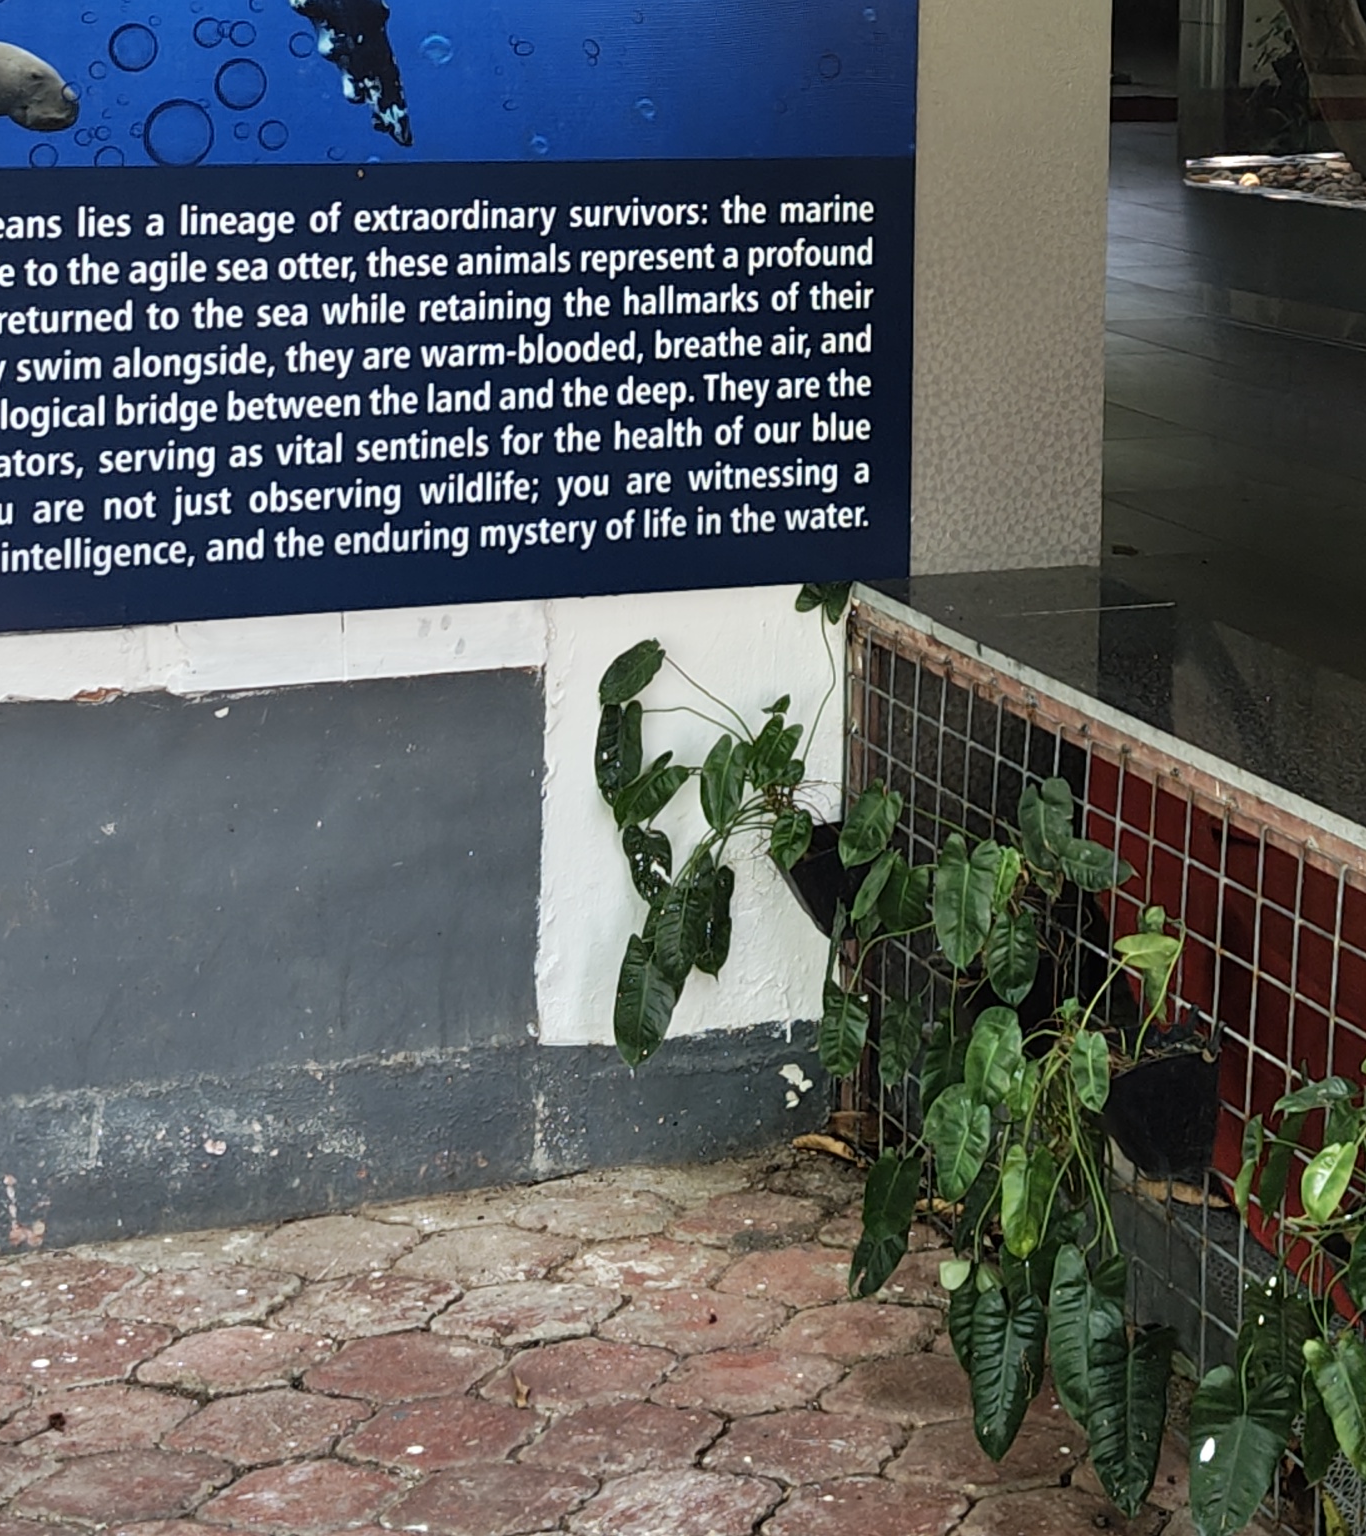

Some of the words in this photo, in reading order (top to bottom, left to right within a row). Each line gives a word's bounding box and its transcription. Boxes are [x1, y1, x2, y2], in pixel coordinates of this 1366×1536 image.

[78, 205, 132, 238] lies
[145, 213, 164, 237] a
[180, 204, 296, 243] lineage
[309, 201, 342, 233] of
[354, 199, 557, 237] extraordinary
[569, 197, 708, 228] survivors:
[720, 194, 767, 224] the
[780, 193, 874, 224] marine
[23, 258, 58, 287] to
[66, 253, 120, 285] the
[128, 251, 207, 292] agile
[216, 258, 268, 282] sea
[278, 252, 357, 283] otter,
[366, 246, 449, 278] these
[456, 242, 571, 276] animals
[580, 243, 715, 280] represent
[722, 247, 739, 269] a
[748, 236, 873, 276] profound
[146, 303, 180, 331] to
[191, 297, 244, 329] the
[256, 303, 308, 328] sea
[321, 292, 406, 325] while
[419, 290, 551, 327] retaining
[563, 287, 611, 318] the
[623, 282, 759, 316] hallmarks
[771, 281, 800, 312] of
[809, 280, 874, 311] their
[16, 349, 102, 383] swim
[112, 342, 275, 385] alongside,
[285, 341, 354, 379] they
[362, 346, 411, 370] are
[420, 330, 644, 368] warm-blooded,
[655, 327, 763, 359] breathe
[770, 326, 811, 359] air,
[820, 323, 872, 354] and
[116, 391, 218, 432] bridge
[227, 390, 361, 422] between
[368, 384, 419, 416] the
[427, 380, 491, 413] land
[499, 378, 554, 411] and
[561, 377, 609, 408] the
[616, 375, 695, 412] deep.
[703, 371, 770, 408] They
[776, 376, 820, 400] are
[826, 367, 872, 398] the
[98, 439, 216, 478] serving
[229, 444, 263, 468] as
[276, 431, 343, 466] vital
[356, 426, 489, 463] sentinels
[500, 424, 544, 456] for
[553, 422, 601, 453] the
[614, 417, 703, 451] health
[714, 415, 744, 446] of
[754, 421, 802, 444] our
[812, 411, 871, 442] blue
[32, 499, 84, 524] are
[104, 491, 157, 521] not
[172, 486, 232, 526] just
[249, 478, 401, 515] observing
[419, 470, 539, 505] wildlife;
[557, 474, 609, 507] you
[626, 471, 672, 495] are
[688, 457, 838, 493] witnessing
[854, 462, 870, 484] a
[206, 528, 265, 562] and
[274, 526, 325, 559] the
[334, 520, 469, 557] enduring
[480, 518, 597, 554] mystery
[605, 508, 636, 541] of
[643, 506, 687, 538] life
[697, 506, 721, 535] in
[730, 503, 776, 534] the
[784, 503, 869, 531] water.
